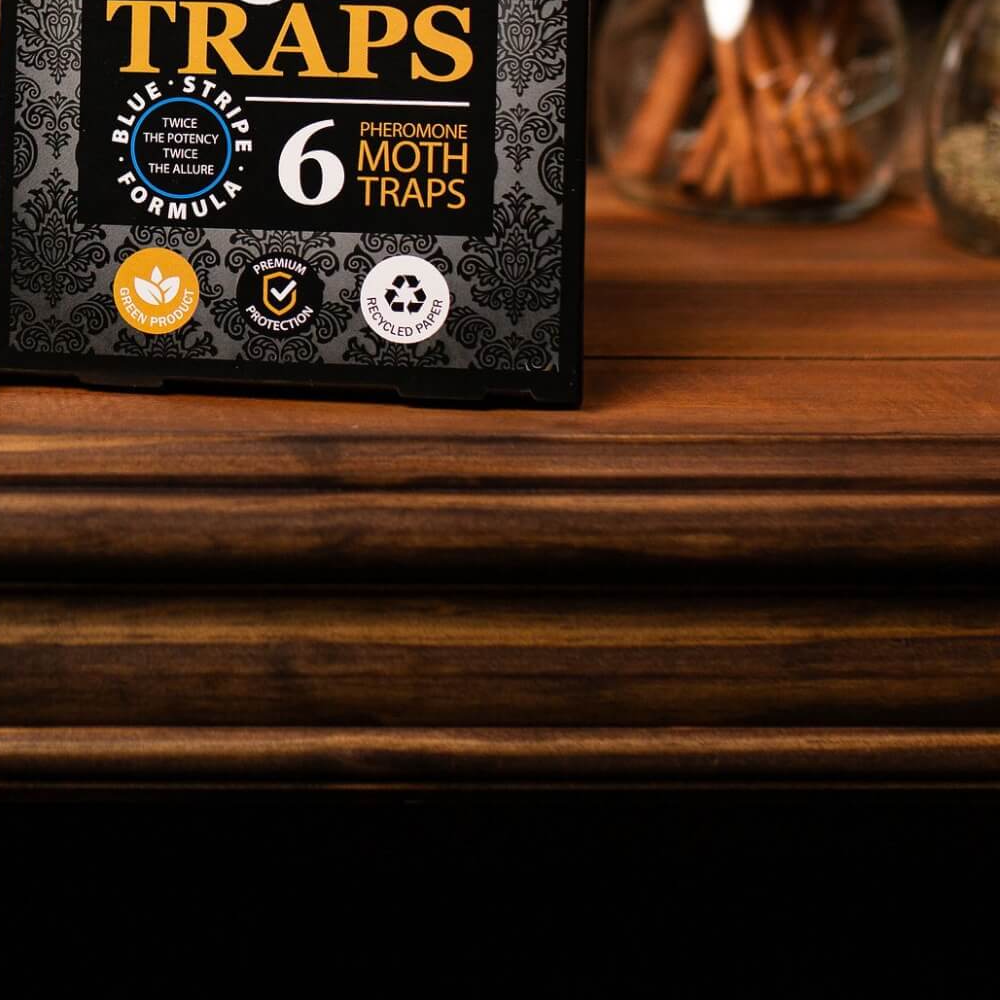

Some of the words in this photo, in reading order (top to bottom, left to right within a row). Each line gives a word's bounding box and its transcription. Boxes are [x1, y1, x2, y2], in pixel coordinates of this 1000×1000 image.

[106, 0, 473, 82] TRAPS
[112, 80, 162, 144] BLUE
[182, 76, 253, 152] STRIPE
[161, 117, 198, 129] TWICE
[143, 132, 165, 144] THE
[167, 132, 220, 145] POTENCY
[360, 122, 468, 140] PHEROMONE
[148, 163, 170, 174] THE
[172, 163, 215, 175] ALLURE
[161, 147, 198, 159] TWICE
[278, 119, 345, 206] 6
[358, 141, 468, 174] MOTH
[117, 169, 242, 220] FORMULA
[357, 176, 466, 209] TRAPS
[252, 258, 307, 275] PREMIUM
[119, 286, 148, 325] GREEN
[150, 289, 195, 328] PRODUCT
[246, 303, 314, 331] PROTECTION
[366, 296, 413, 337] RECYCLED
[415, 298, 443, 334] PAPER
